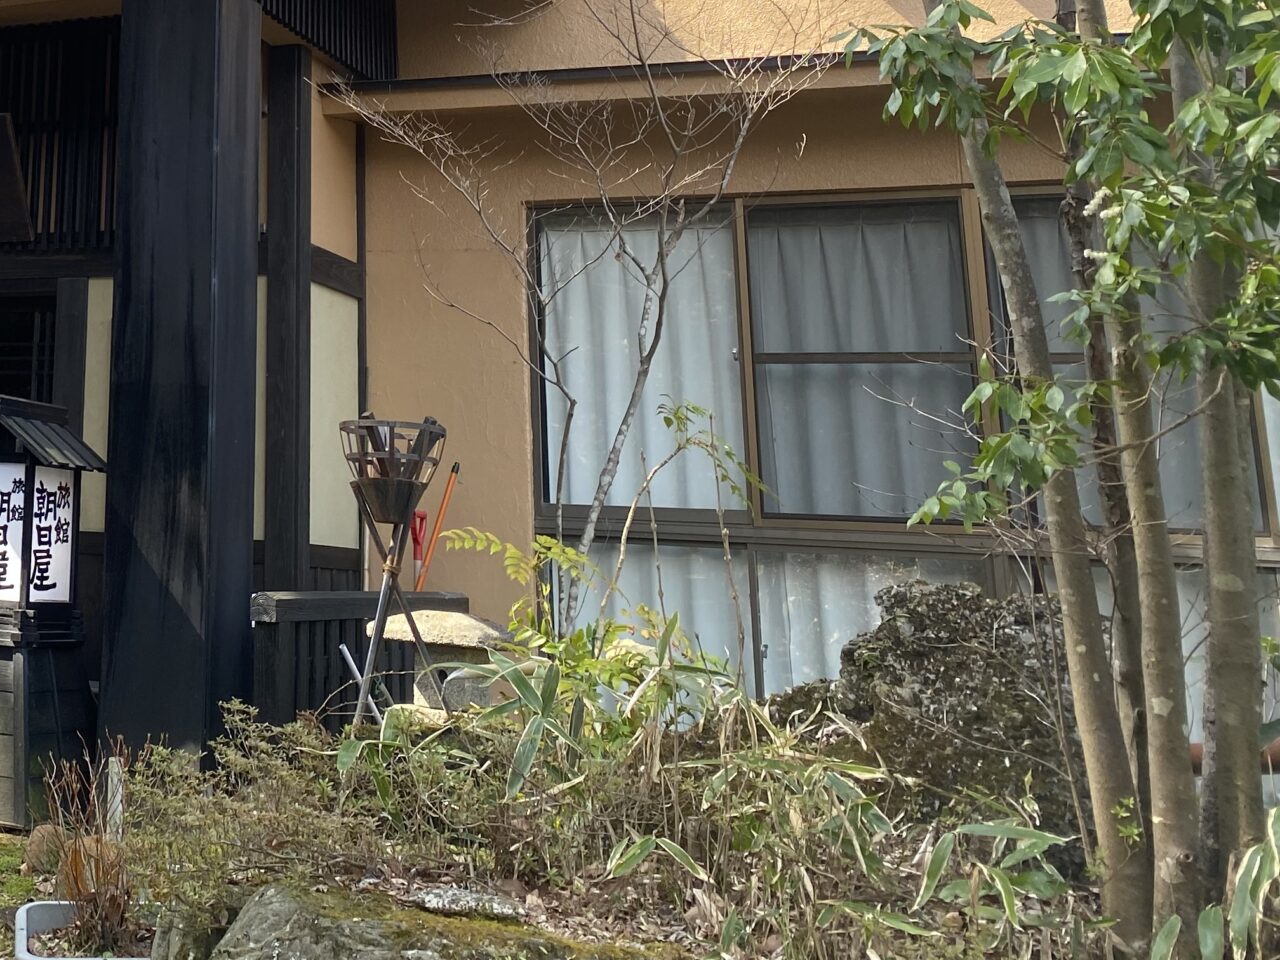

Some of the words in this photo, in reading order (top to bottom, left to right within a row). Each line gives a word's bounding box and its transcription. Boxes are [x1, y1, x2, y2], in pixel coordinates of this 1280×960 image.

[30, 480, 57, 591] 朝日屋
[55, 481, 71, 545] 旅館
